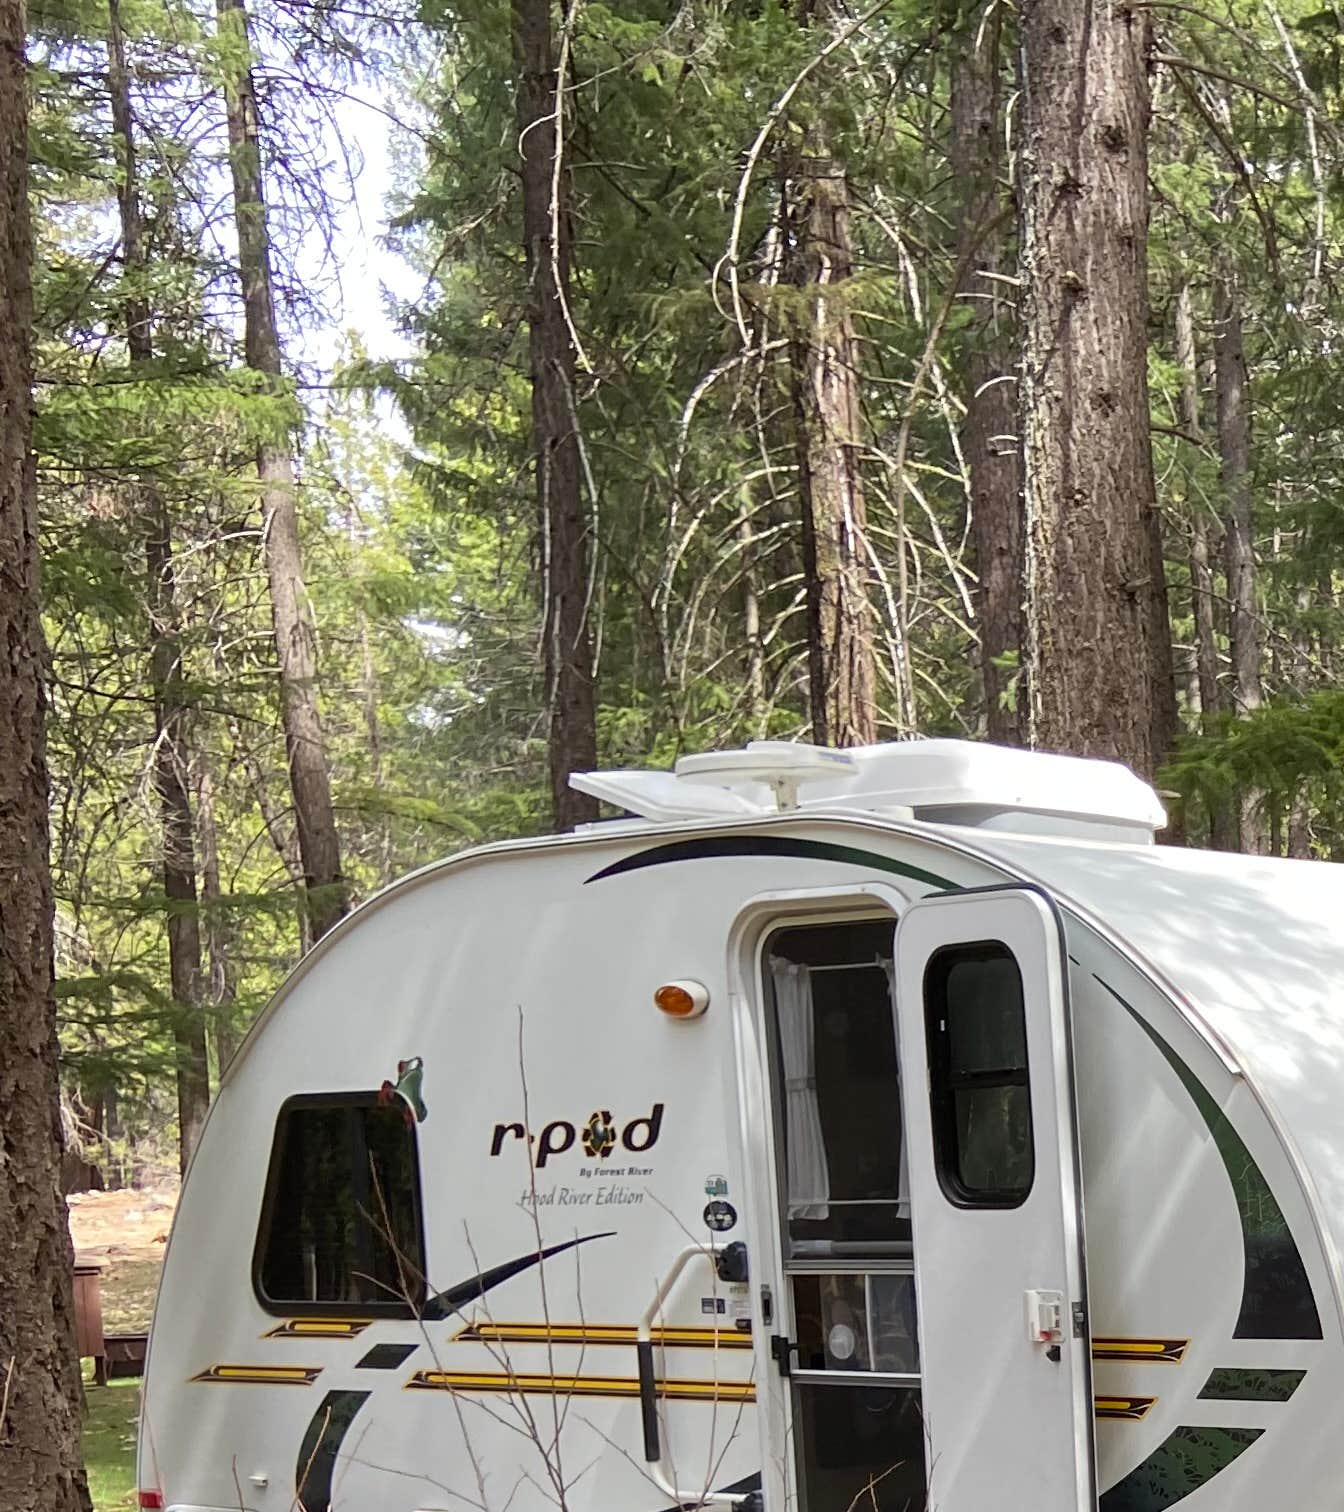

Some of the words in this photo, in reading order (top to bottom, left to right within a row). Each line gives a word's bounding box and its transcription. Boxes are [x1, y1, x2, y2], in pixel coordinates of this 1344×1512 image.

[579, 1167, 592, 1178] By
[594, 1167, 626, 1177] Forest
[627, 1166, 654, 1176] River
[520, 1185, 557, 1206] Hood
[557, 1187, 593, 1206] River
[595, 1184, 644, 1206] Edition
